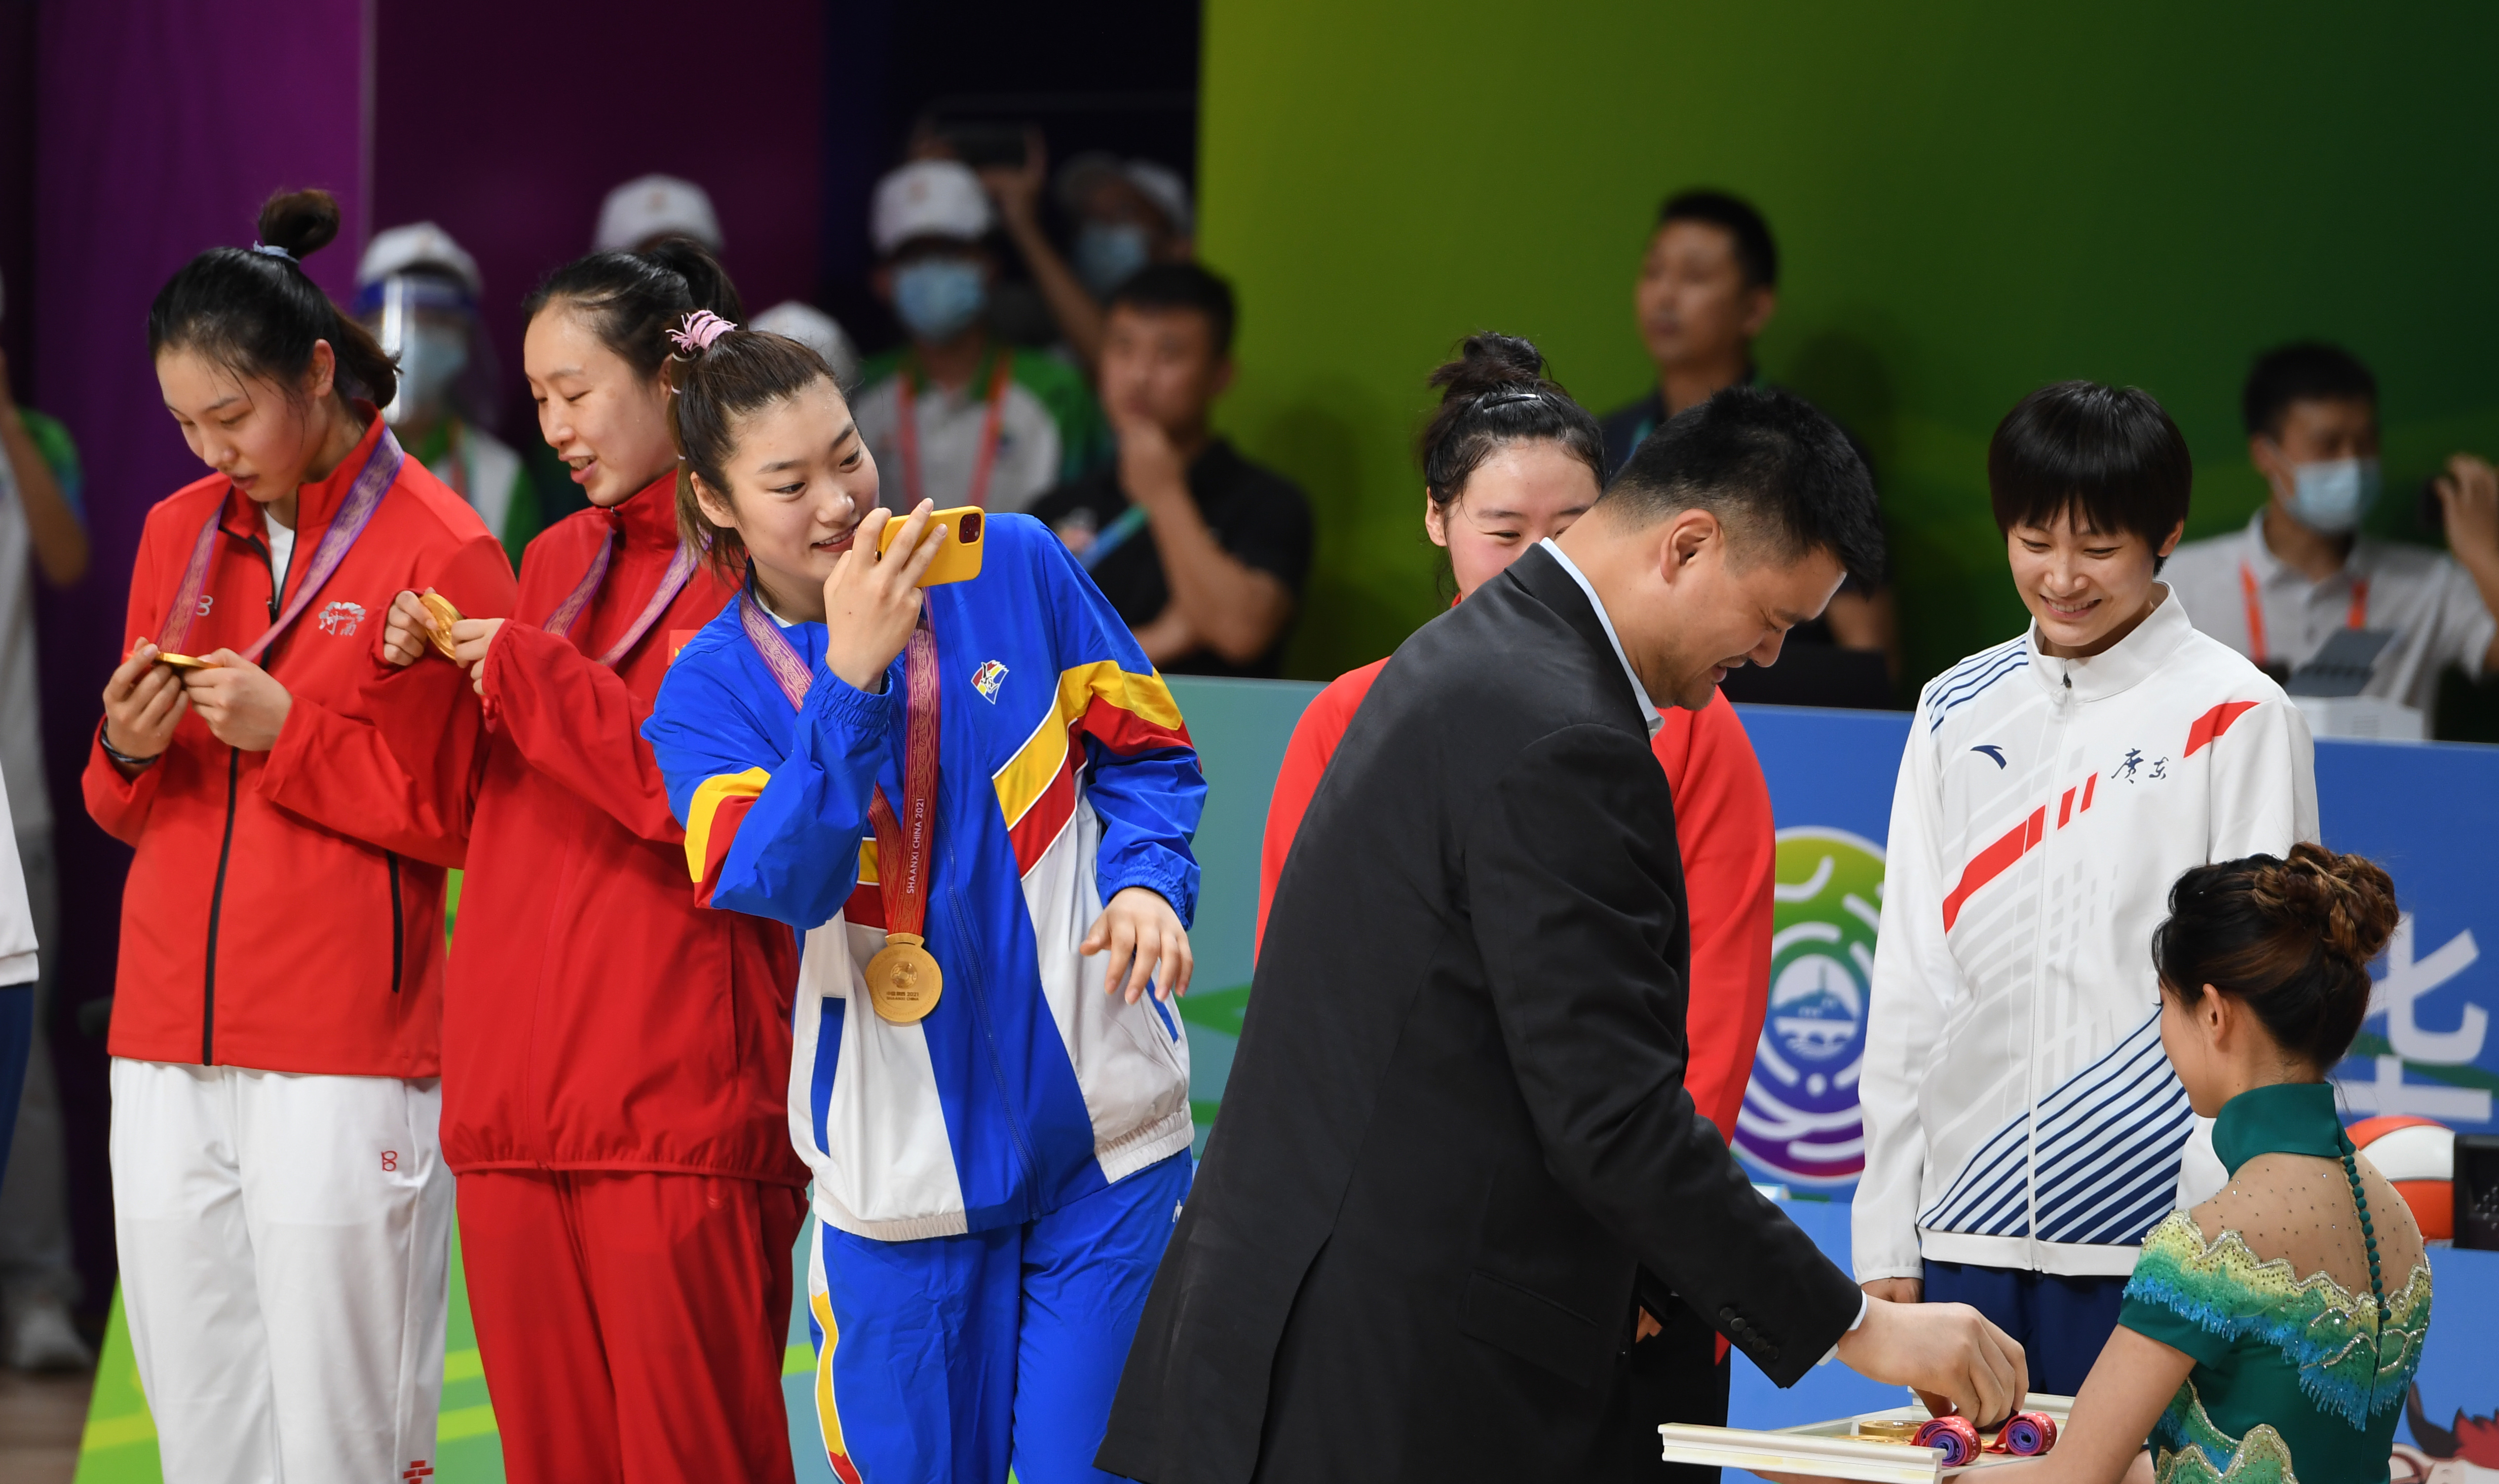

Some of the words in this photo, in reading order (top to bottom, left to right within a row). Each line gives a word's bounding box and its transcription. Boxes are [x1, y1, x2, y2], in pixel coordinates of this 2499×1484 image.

[915, 798, 924, 818] 2021
[912, 821, 922, 849] CHINA
[907, 852, 919, 894] SHAANXI
